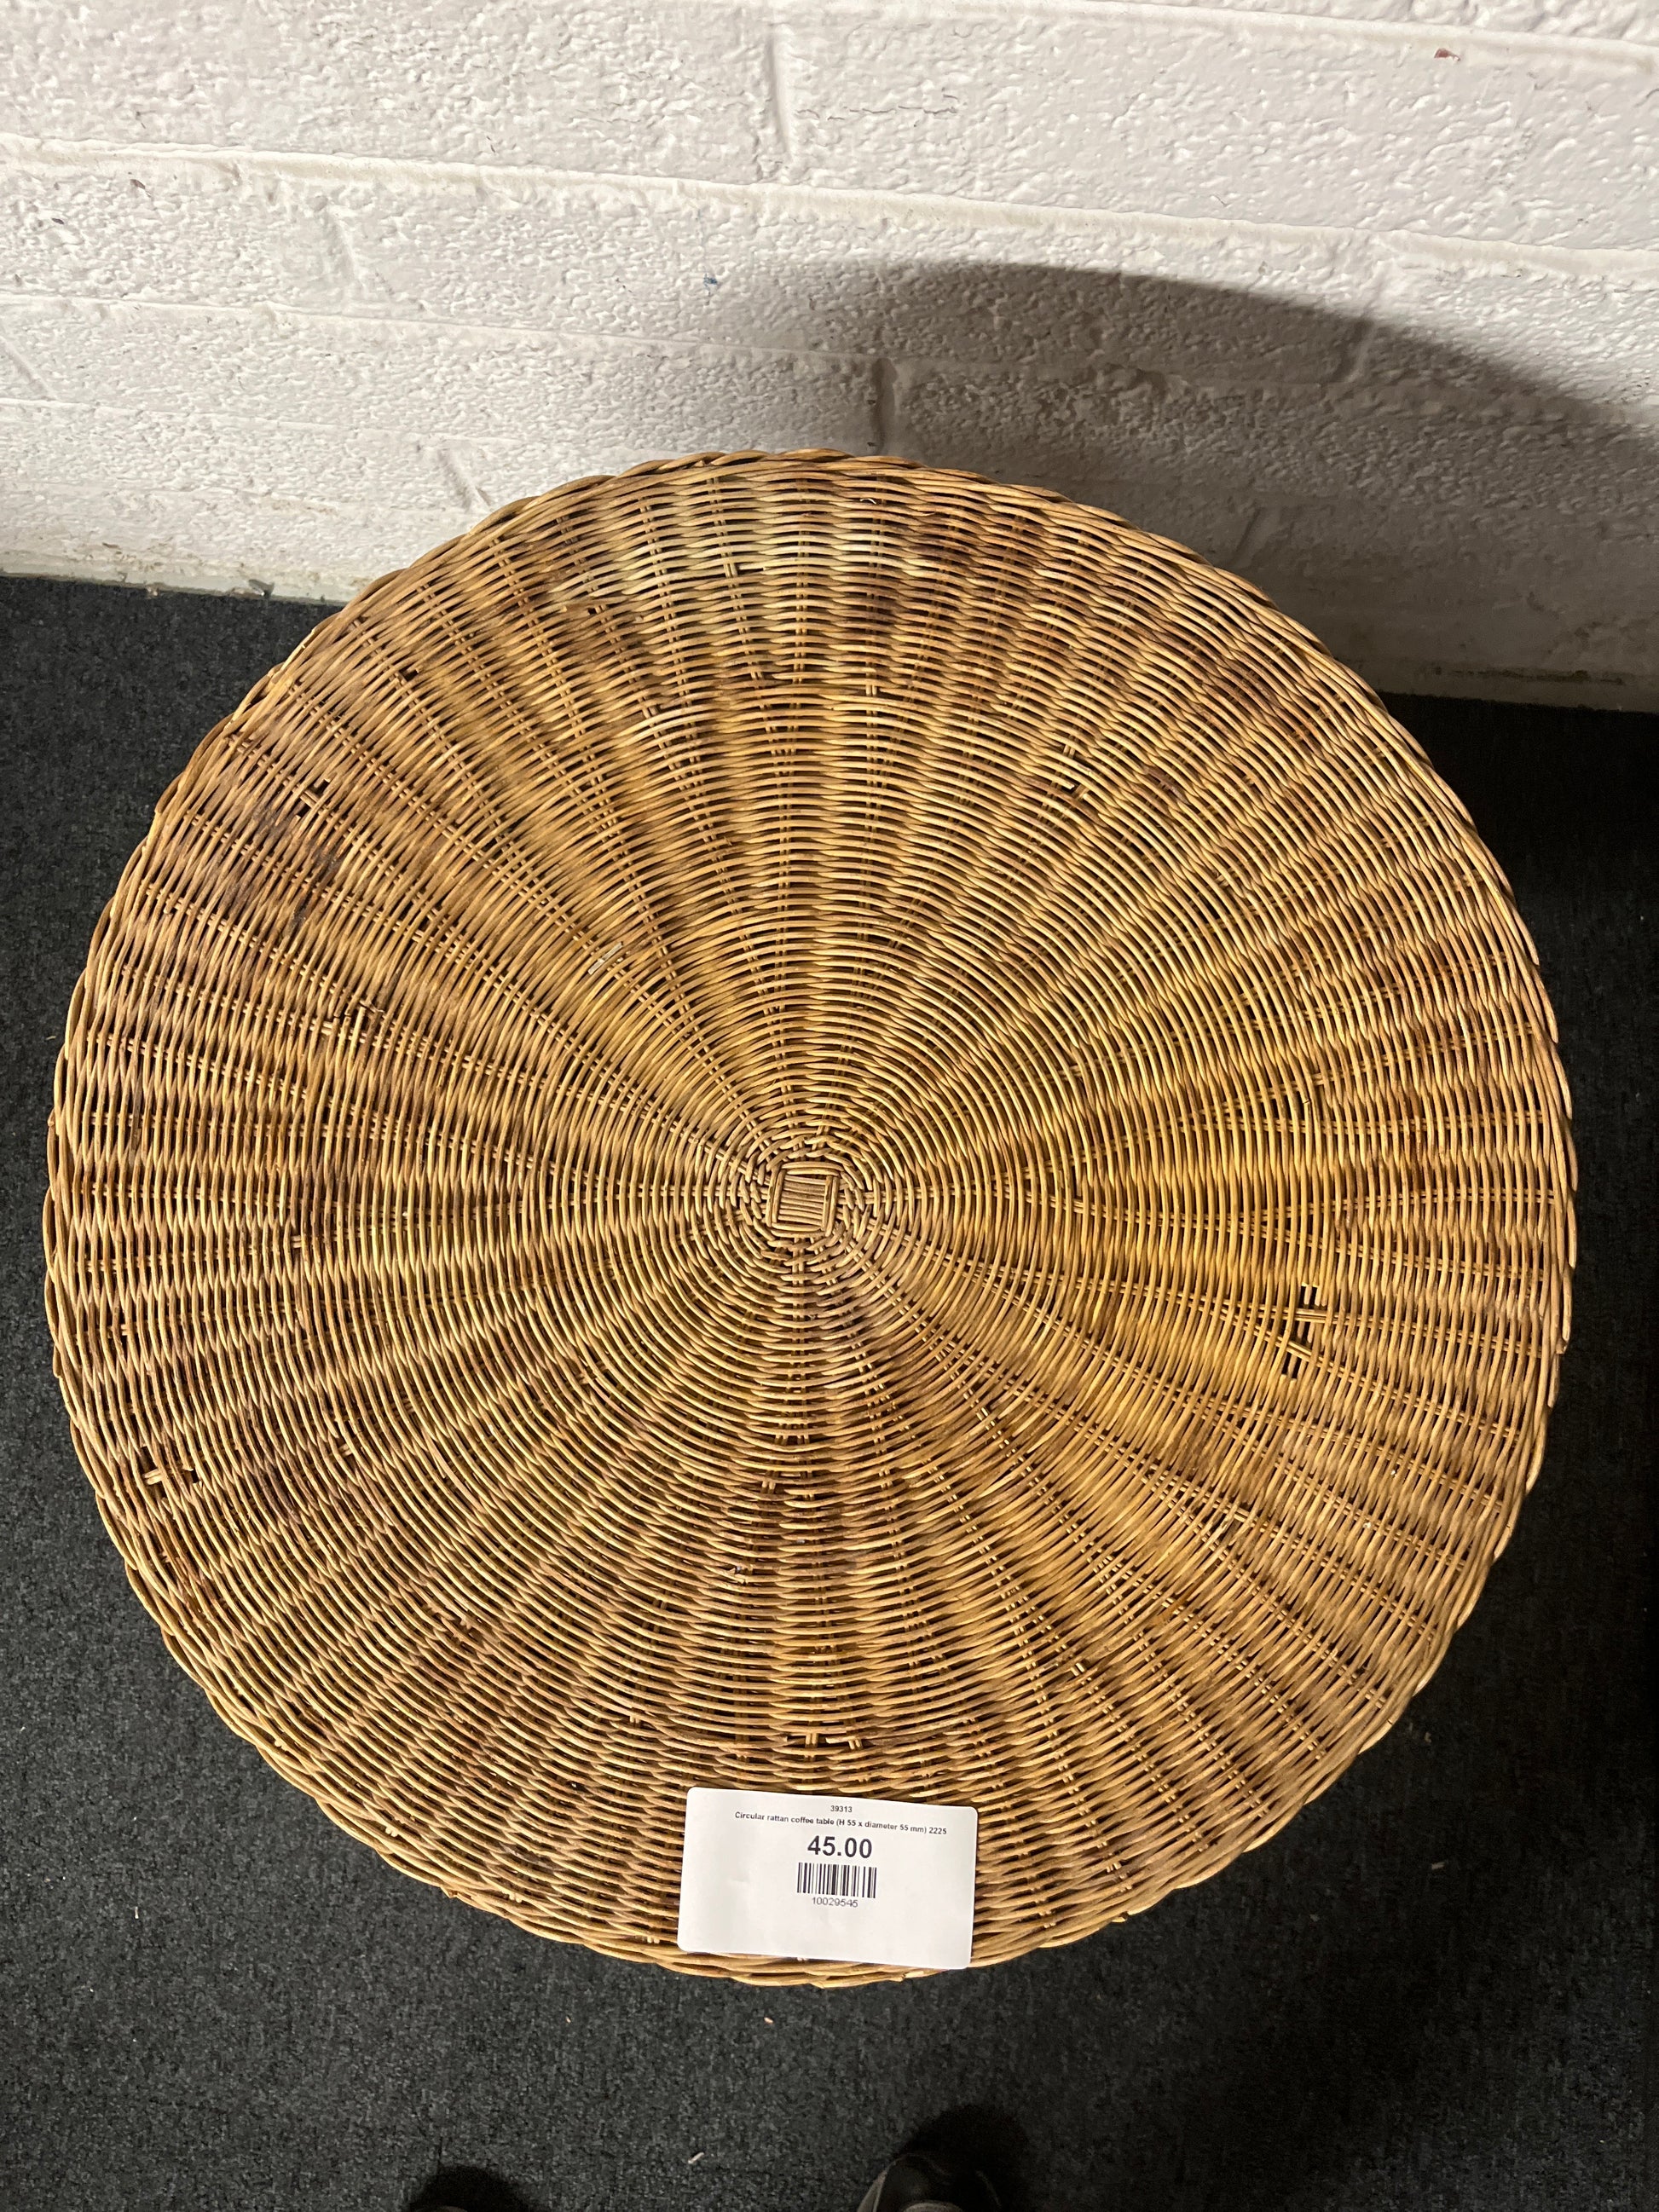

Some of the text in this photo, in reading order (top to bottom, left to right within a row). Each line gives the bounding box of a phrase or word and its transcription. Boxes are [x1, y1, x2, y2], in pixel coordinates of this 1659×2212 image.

[735, 1811, 765, 1820] Circular
[864, 1822, 898, 1830] diameter
[807, 1835, 872, 1858] 45.00
[812, 1897, 858, 1908] 10029545
